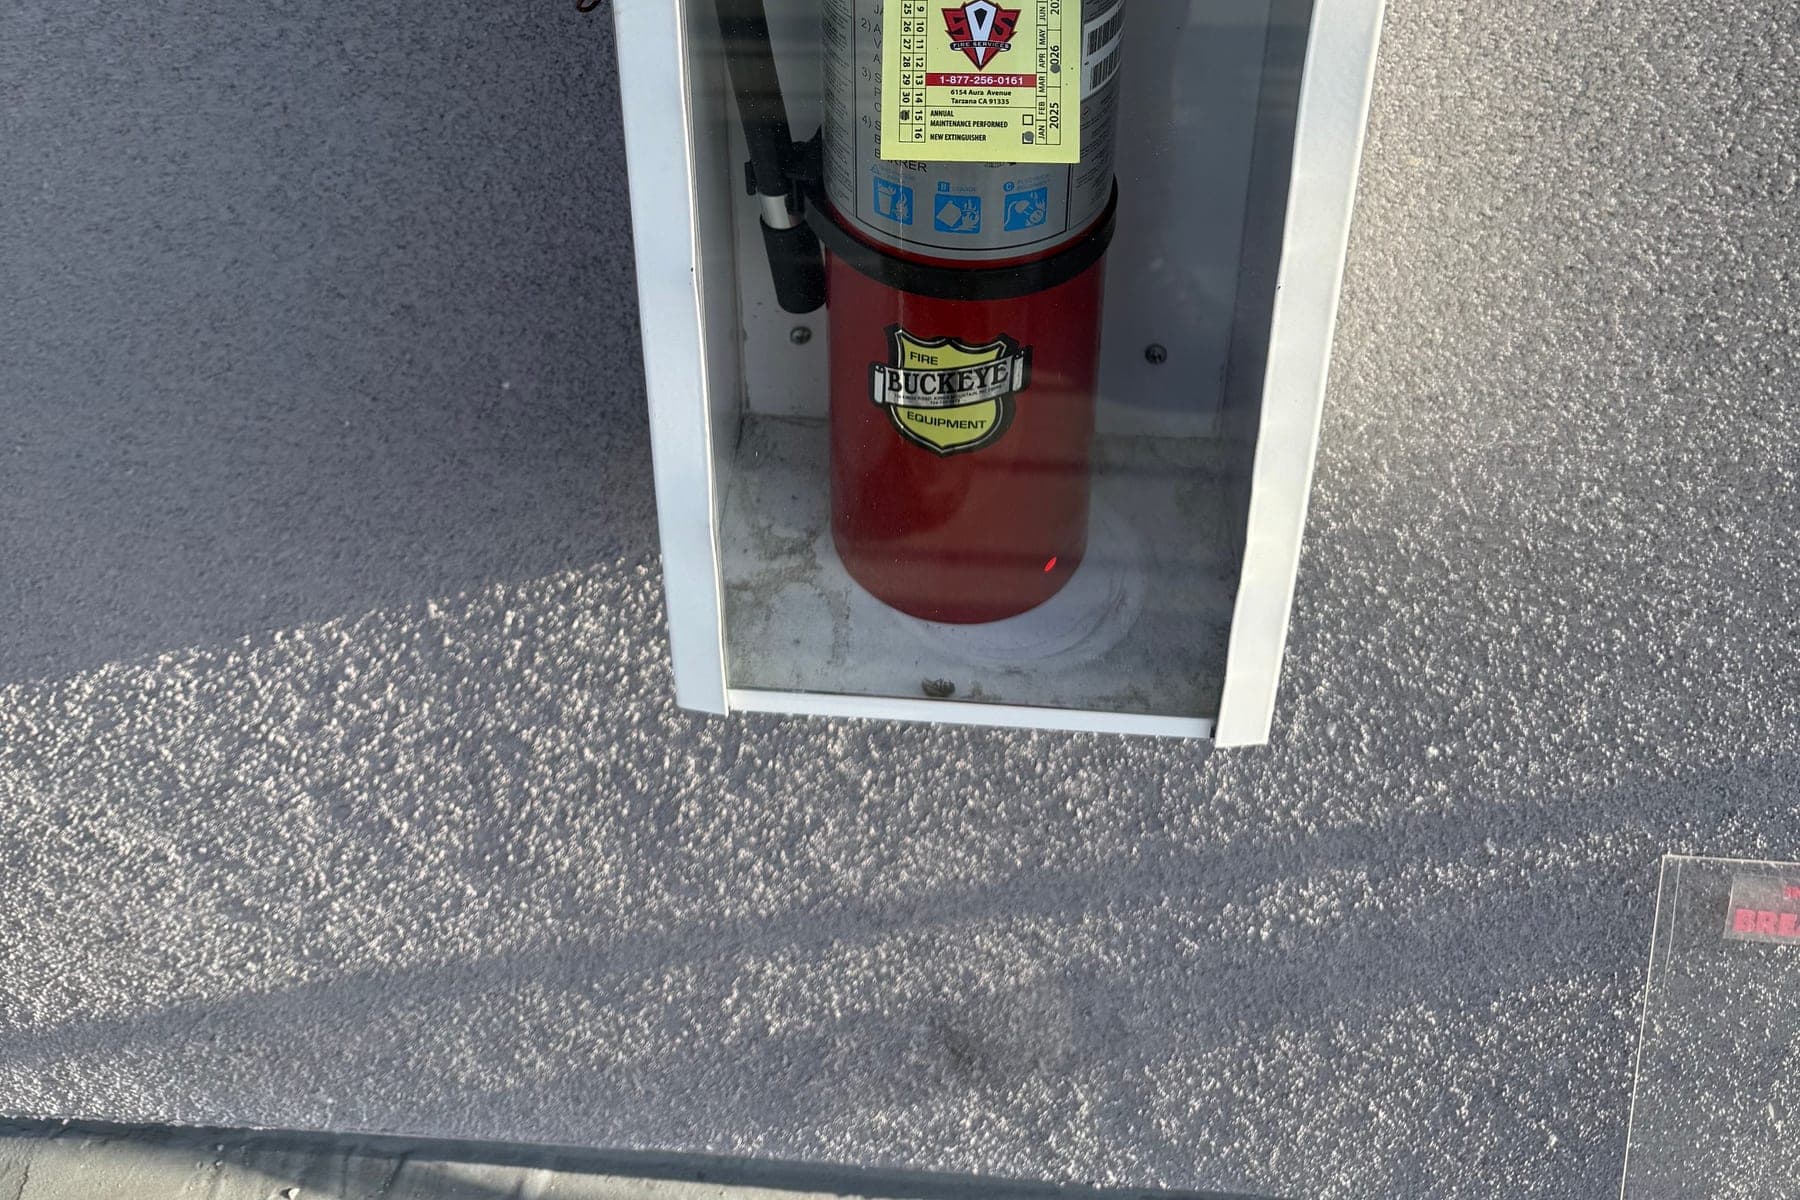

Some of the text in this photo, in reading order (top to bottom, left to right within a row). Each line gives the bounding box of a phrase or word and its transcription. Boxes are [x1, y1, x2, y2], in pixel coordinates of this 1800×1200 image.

[904, 4, 912, 15] 25
[904, 21, 912, 33] 26
[916, 22, 924, 32] 10
[903, 39, 911, 50] 27
[916, 40, 924, 49] 11
[953, 40, 1010, 49] FIRE SERVICES
[903, 57, 911, 68] 28
[916, 57, 923, 68] 12
[1050, 45, 1060, 71] 026
[903, 74, 910, 85] 29
[915, 75, 923, 86] 13
[939, 76, 1024, 85] 1-877-256-0161
[902, 92, 910, 103] 30
[915, 93, 923, 103] 14
[915, 110, 922, 121] 15
[1049, 102, 1059, 129] 2025
[930, 120, 972, 128] MAINTENANCE
[914, 128, 922, 139] 16
[909, 351, 938, 366] FIRE
[888, 361, 1009, 395] BUCKEYE
[906, 410, 987, 430] EQUIPMENT
[1733, 908, 1800, 936] BRE
